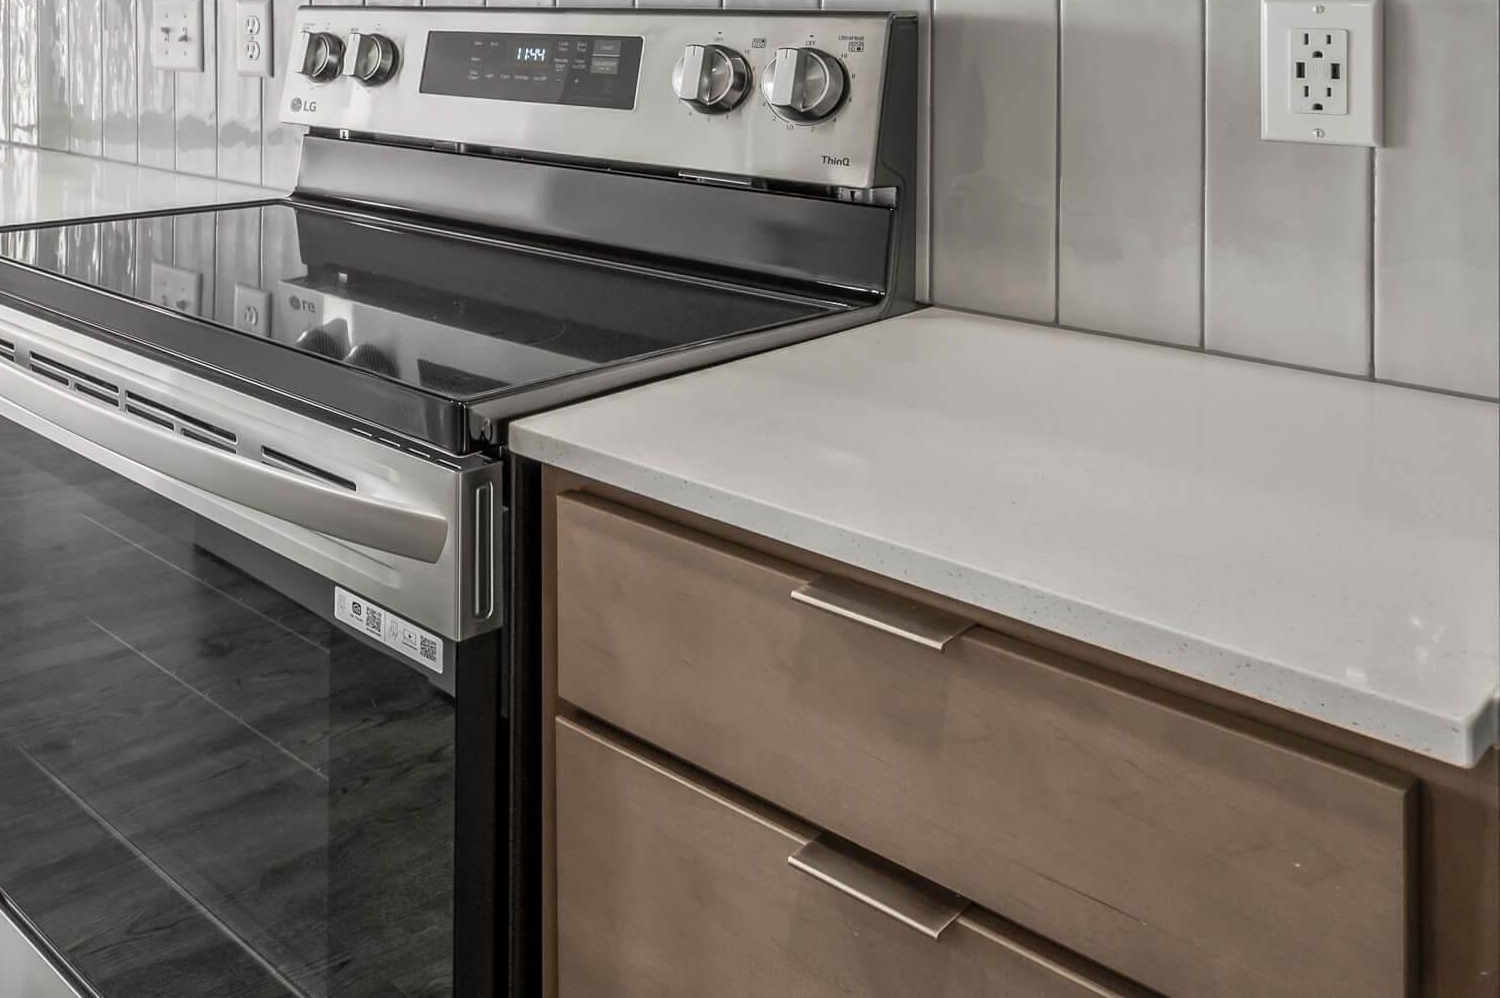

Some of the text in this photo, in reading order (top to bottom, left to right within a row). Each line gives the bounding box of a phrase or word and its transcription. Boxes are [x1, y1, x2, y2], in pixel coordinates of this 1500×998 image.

[517, 47, 546, 62] 11:44
[303, 100, 317, 112] LG
[821, 155, 851, 167] ThinQ
